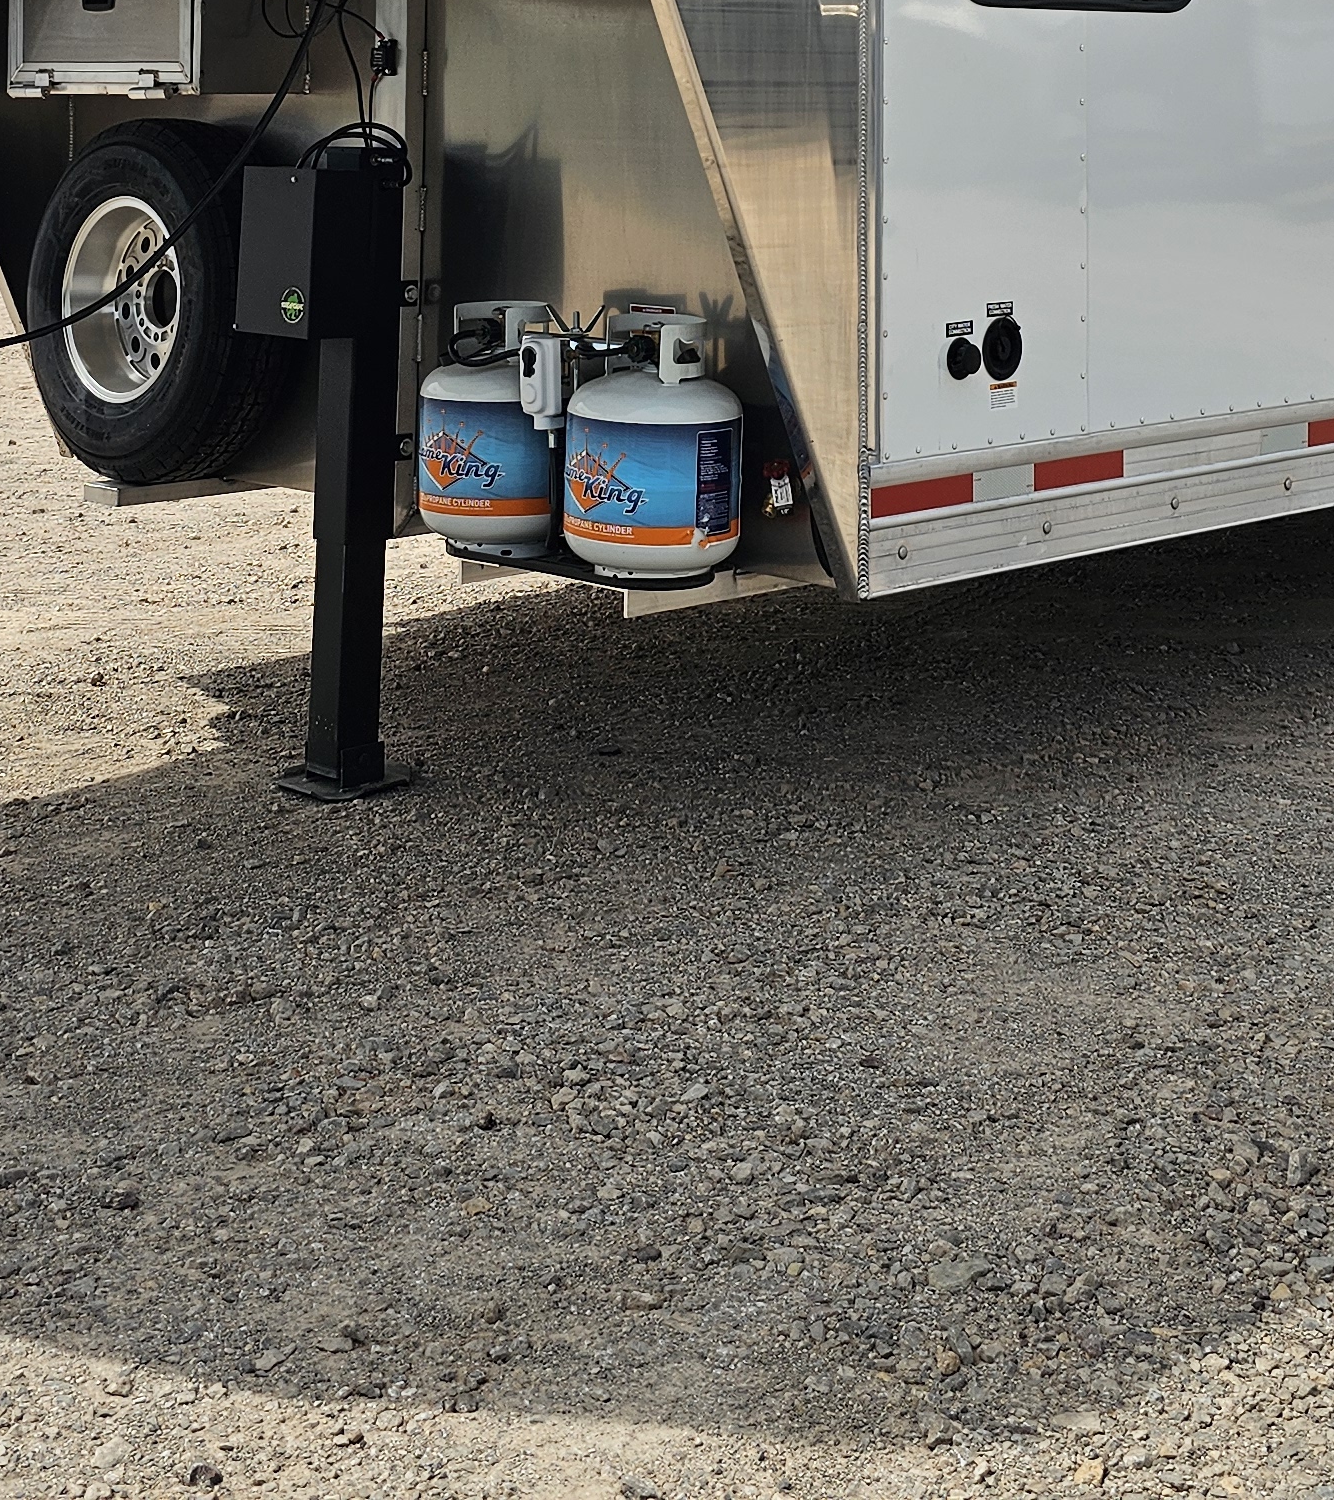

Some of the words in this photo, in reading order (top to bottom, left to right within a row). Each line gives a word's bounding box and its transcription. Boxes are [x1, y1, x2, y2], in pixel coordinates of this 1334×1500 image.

[440, 452, 506, 490] King
[452, 497, 491, 508] CYLINDER
[582, 474, 650, 515] King
[593, 522, 633, 536] CYLINDER
